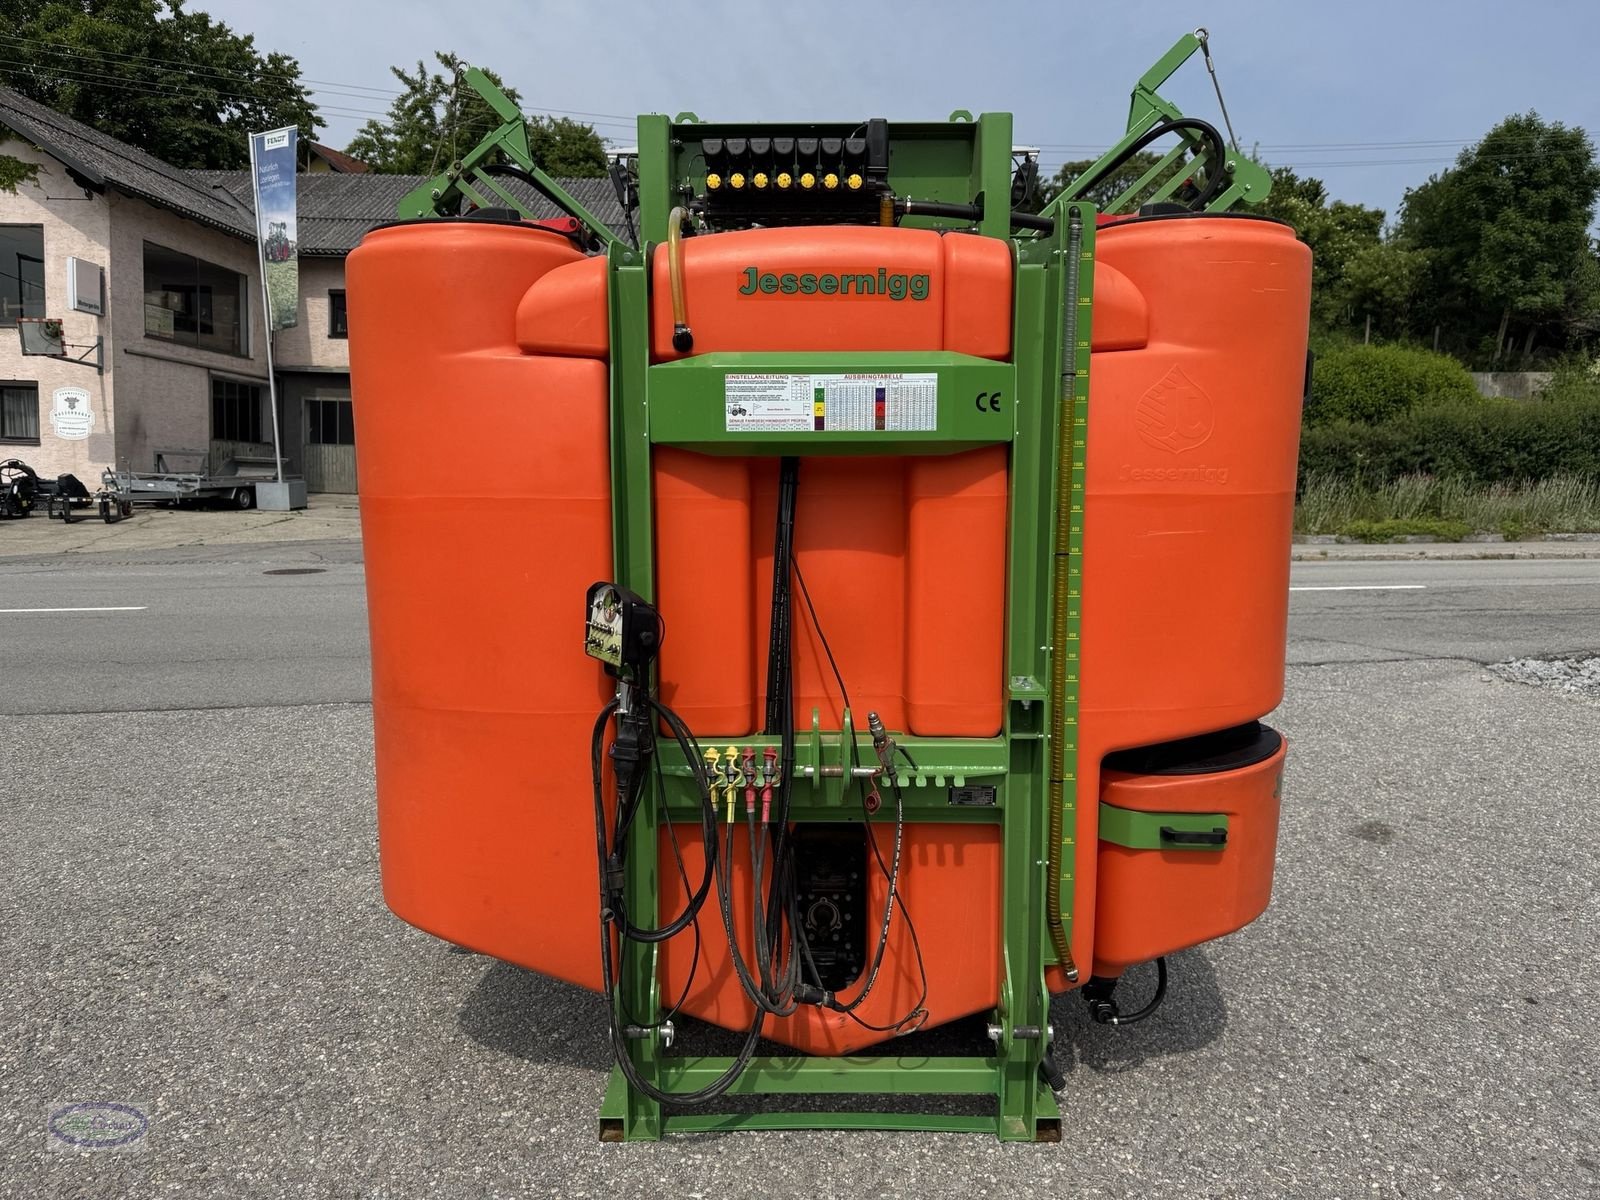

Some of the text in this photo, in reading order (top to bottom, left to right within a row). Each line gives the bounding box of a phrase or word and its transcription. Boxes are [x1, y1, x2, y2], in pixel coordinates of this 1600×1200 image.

[738, 267, 930, 300] Jessernigg
[976, 392, 1001, 412] CE
[1120, 464, 1229, 485] Jessernigg
